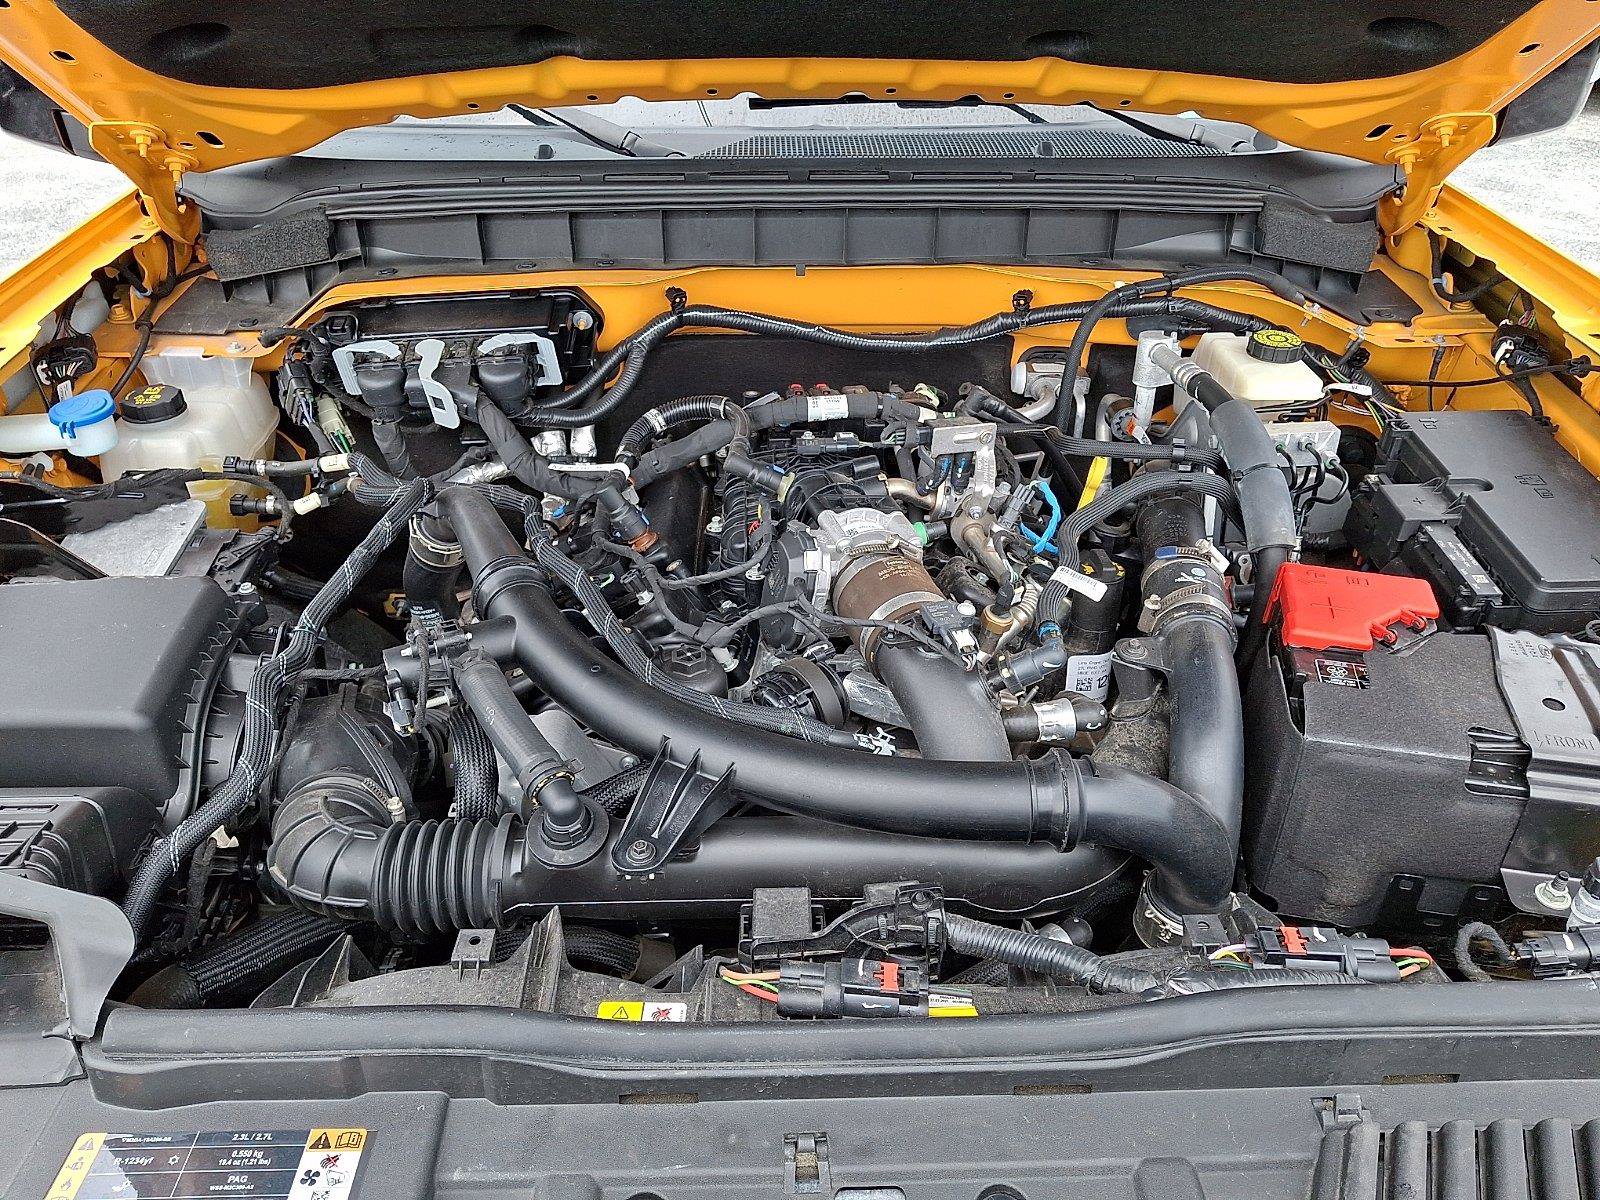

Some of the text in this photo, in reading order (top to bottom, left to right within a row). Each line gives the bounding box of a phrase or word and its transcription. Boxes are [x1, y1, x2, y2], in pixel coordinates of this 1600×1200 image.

[1544, 734, 1595, 751] FRONT
[252, 1149, 264, 1159] kg
[114, 1156, 154, 1166] R-1234yf
[227, 1175, 249, 1184] PAG
